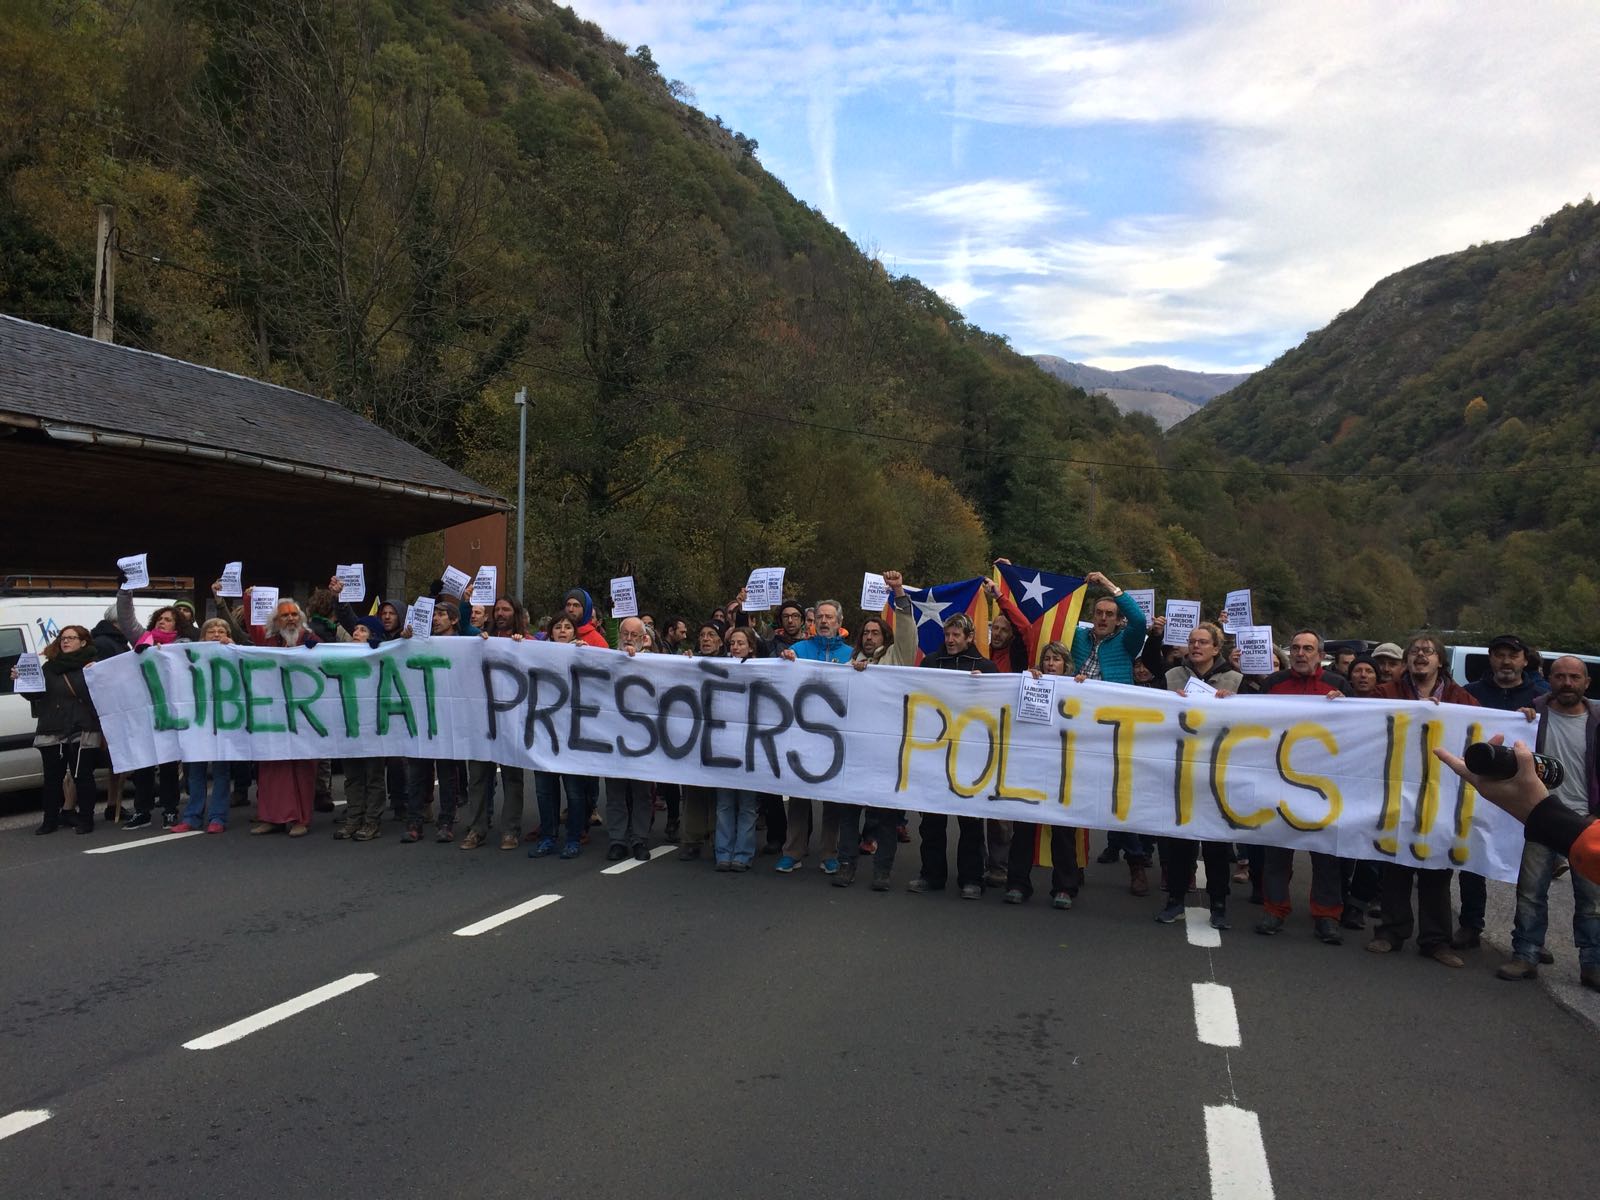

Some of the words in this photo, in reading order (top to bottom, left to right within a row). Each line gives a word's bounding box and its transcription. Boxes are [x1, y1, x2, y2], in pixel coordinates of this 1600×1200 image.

[1024, 686, 1052, 694] LLIBERTAT
[1024, 696, 1050, 704] POLÍTICS
[482, 659, 847, 784] PRESOÈRS
